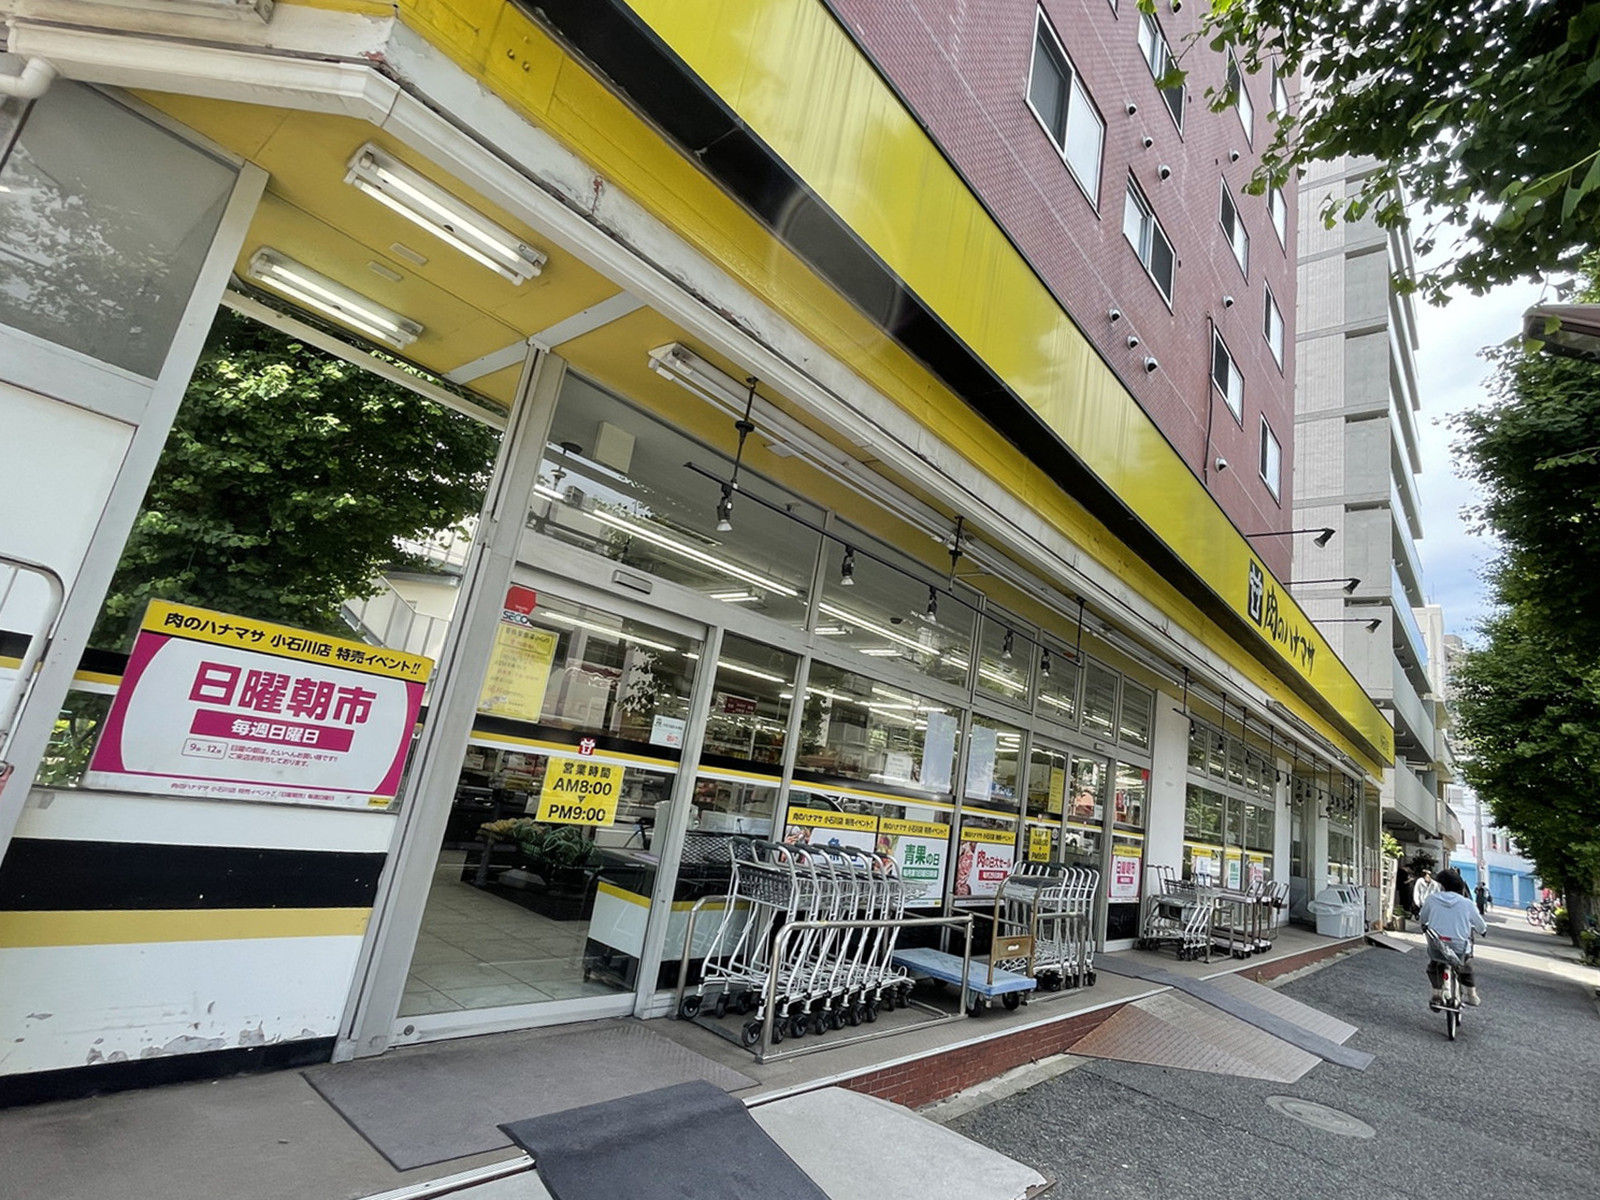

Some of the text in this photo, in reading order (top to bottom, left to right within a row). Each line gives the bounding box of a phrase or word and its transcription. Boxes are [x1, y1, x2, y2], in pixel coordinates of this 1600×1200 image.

[164, 612, 266, 644] 肉のハナマサ
[270, 635, 331, 658] 小石川店
[1262, 584, 1315, 677] 肉のハナマサ
[189, 661, 377, 725] 日曜朝市
[231, 719, 319, 744] 毎週日曜日
[563, 761, 612, 779] 営業時間
[553, 777, 612, 796] AM8:00
[548, 804, 606, 822] PM9:00
[904, 844, 940, 866] 青果の日
